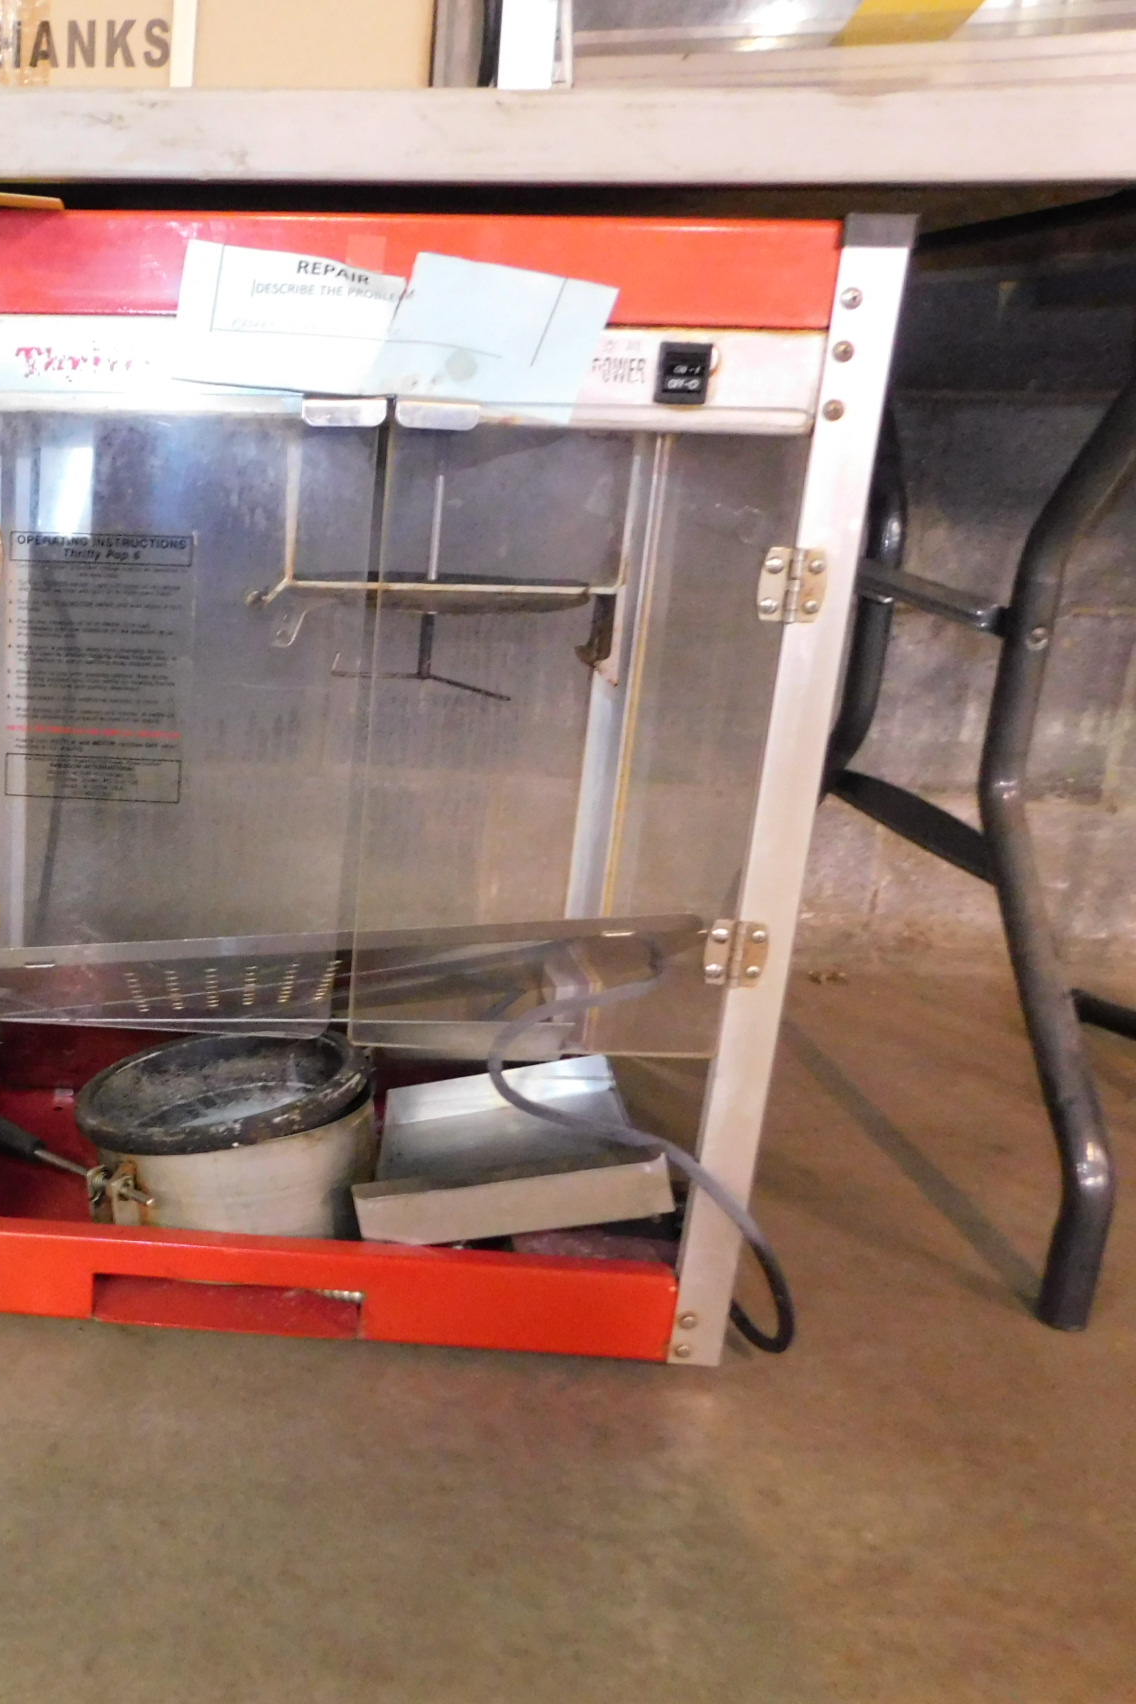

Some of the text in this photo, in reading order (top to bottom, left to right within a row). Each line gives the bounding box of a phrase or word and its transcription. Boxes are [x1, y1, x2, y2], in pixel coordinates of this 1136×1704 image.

[296, 259, 370, 286] REPAIR
[319, 284, 343, 297] THE
[17, 534, 187, 550] OPERATING INSTRUCTIONS
[63, 548, 100, 561] Thrifty
[105, 550, 129, 561] Pop
